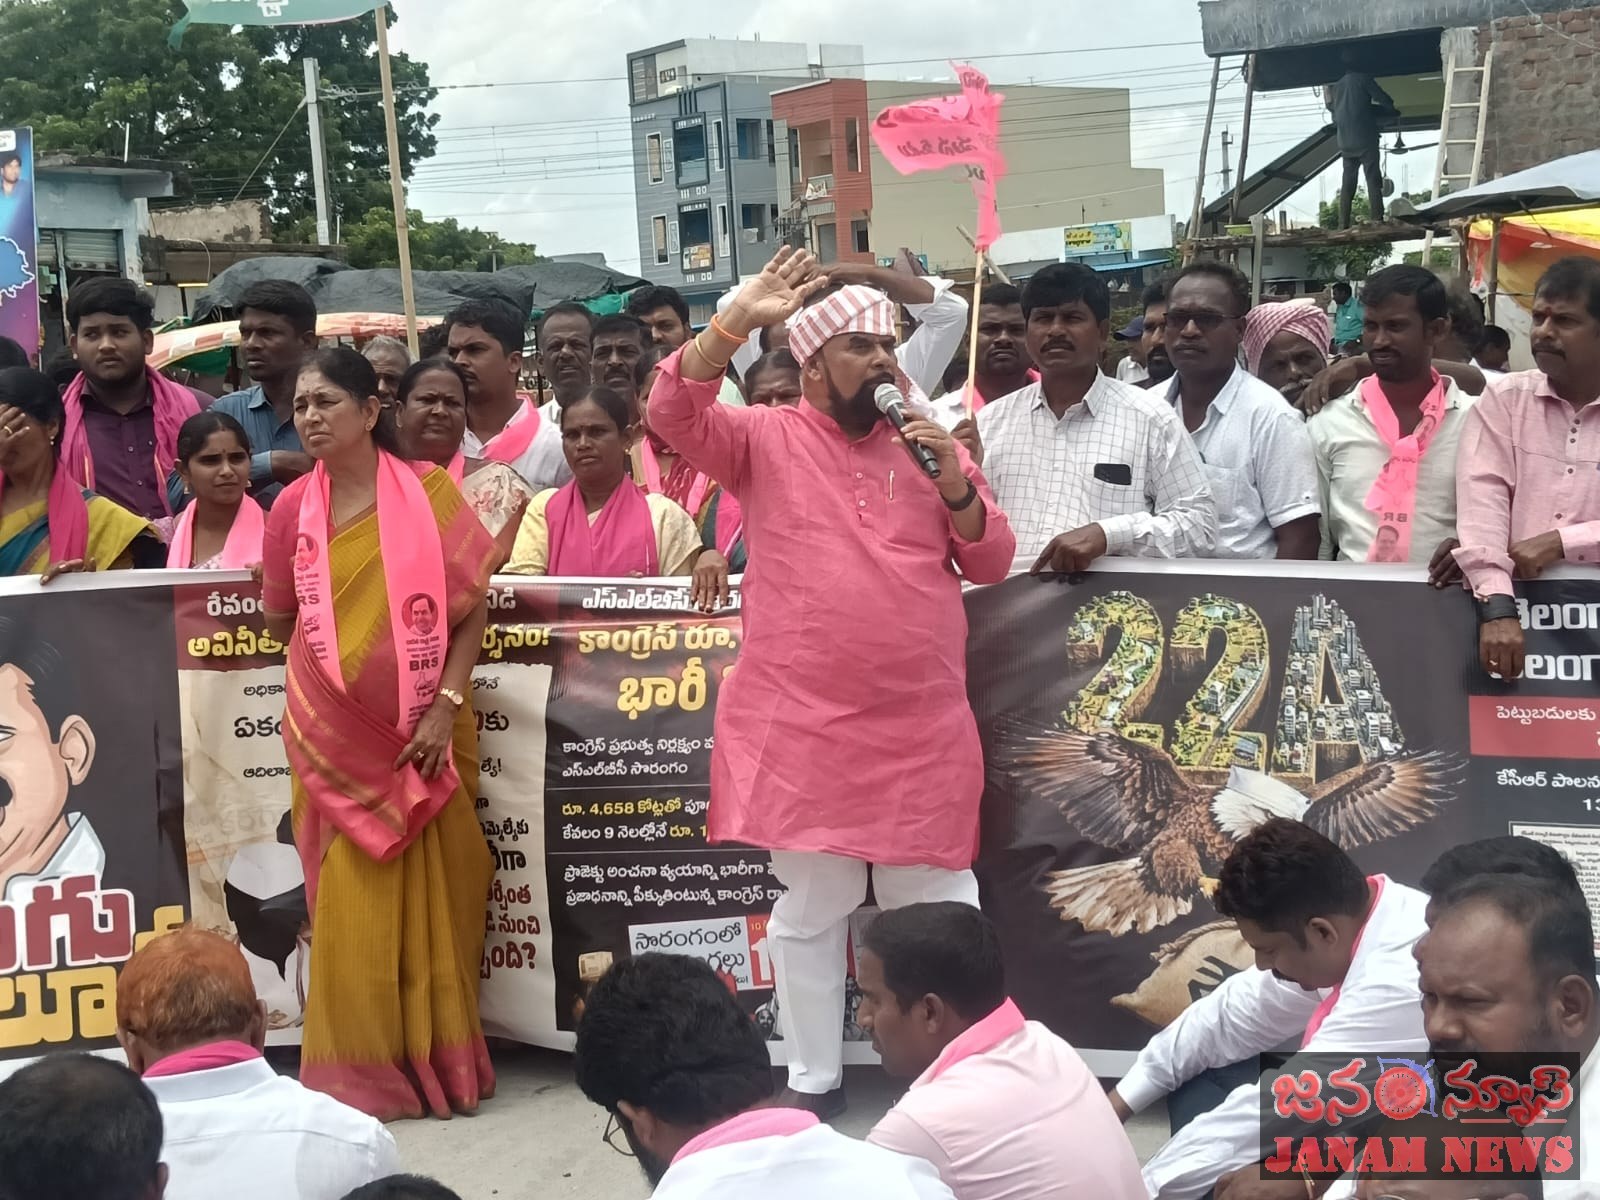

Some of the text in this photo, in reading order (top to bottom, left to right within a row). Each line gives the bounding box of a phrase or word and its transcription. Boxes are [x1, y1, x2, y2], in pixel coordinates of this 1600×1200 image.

[578, 622, 737, 660] కాంగ్రెస్ రూ.
[409, 657, 439, 671] BRS
[617, 657, 707, 720] భారీ
[1060, 590, 1406, 786] 22A
[1496, 705, 1597, 725] పెట్టుబడులకు
[562, 737, 606, 756] కాంగ్రెస్
[608, 738, 654, 756] ప్రభుత్వ
[637, 797, 681, 817] కోట్లతో
[562, 823, 601, 840] కేవలం
[604, 826, 614, 839] 9
[617, 822, 667, 842] నెలల్లోనే
[564, 864, 604, 884] ప్రాజెక్టు
[607, 864, 657, 878] అంచనా
[659, 863, 719, 882] వ్యయాన్ని
[720, 859, 764, 878] భారీగా
[717, 884, 764, 905] కాంగ్రెస్
[498, 913, 541, 935] నుంచి
